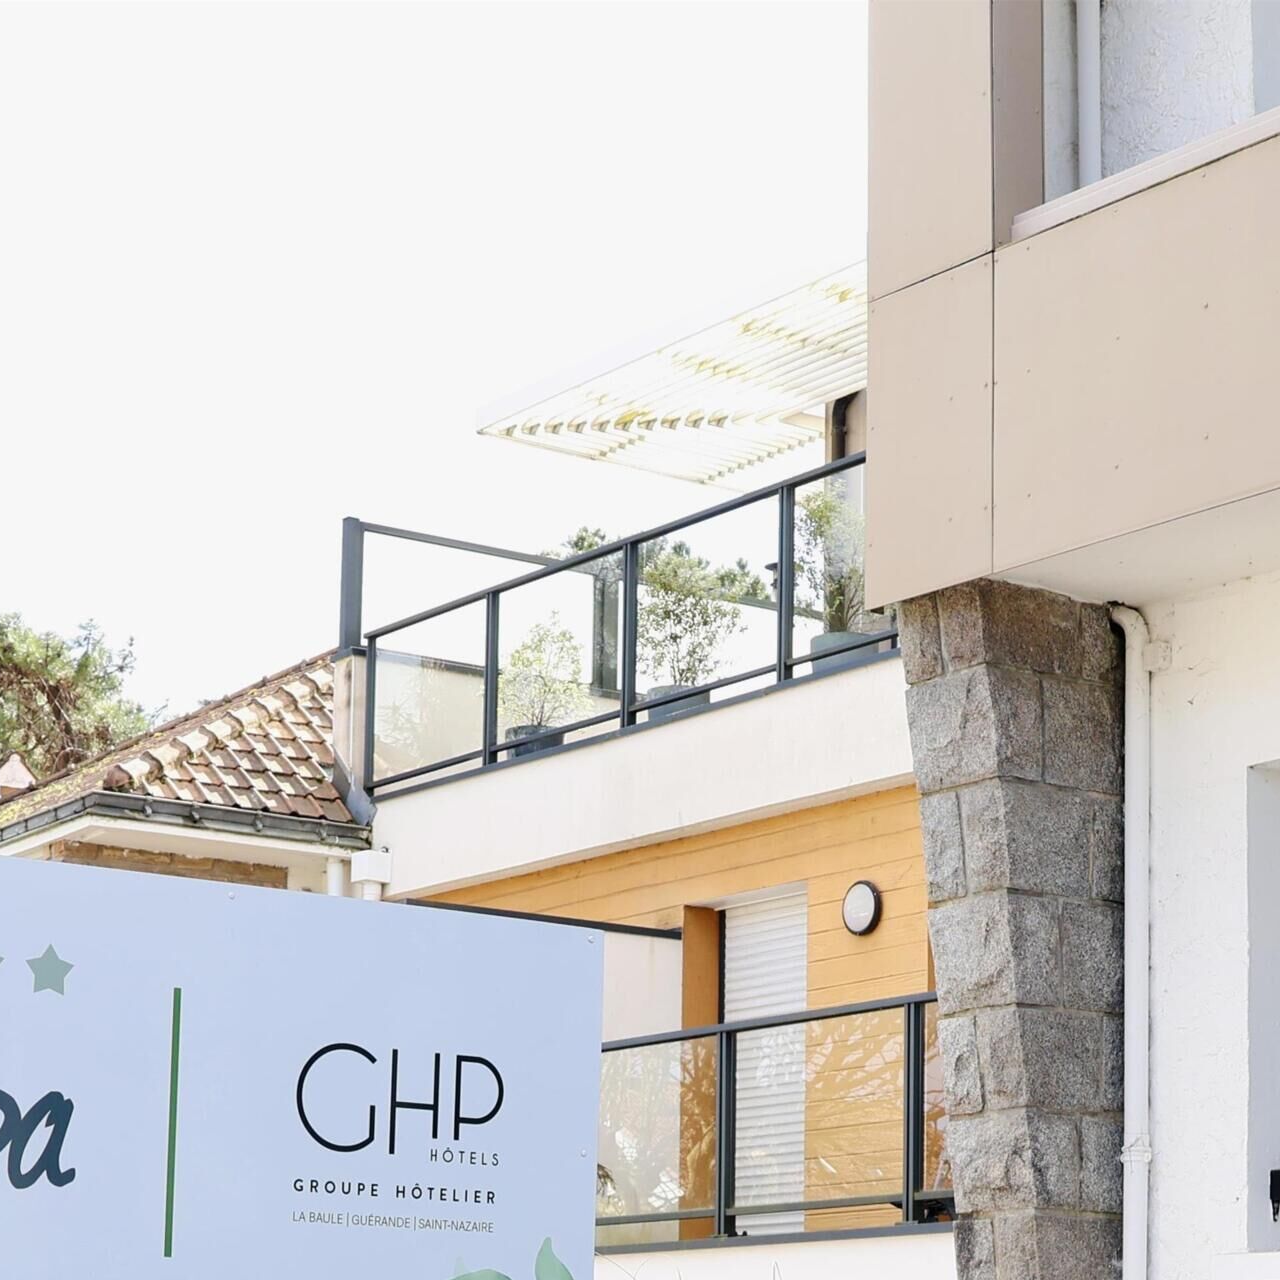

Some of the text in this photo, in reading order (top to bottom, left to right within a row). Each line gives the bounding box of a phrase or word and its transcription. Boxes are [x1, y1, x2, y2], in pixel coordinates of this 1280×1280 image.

[296, 1042, 505, 1155] GHP
[430, 1146, 499, 1166] HÔTELS
[293, 1178, 496, 1204] GROUPE HÔTELIER
[292, 1211, 494, 1233] LA BAULE GUÉRANDE SAINT-NAZAIRE
